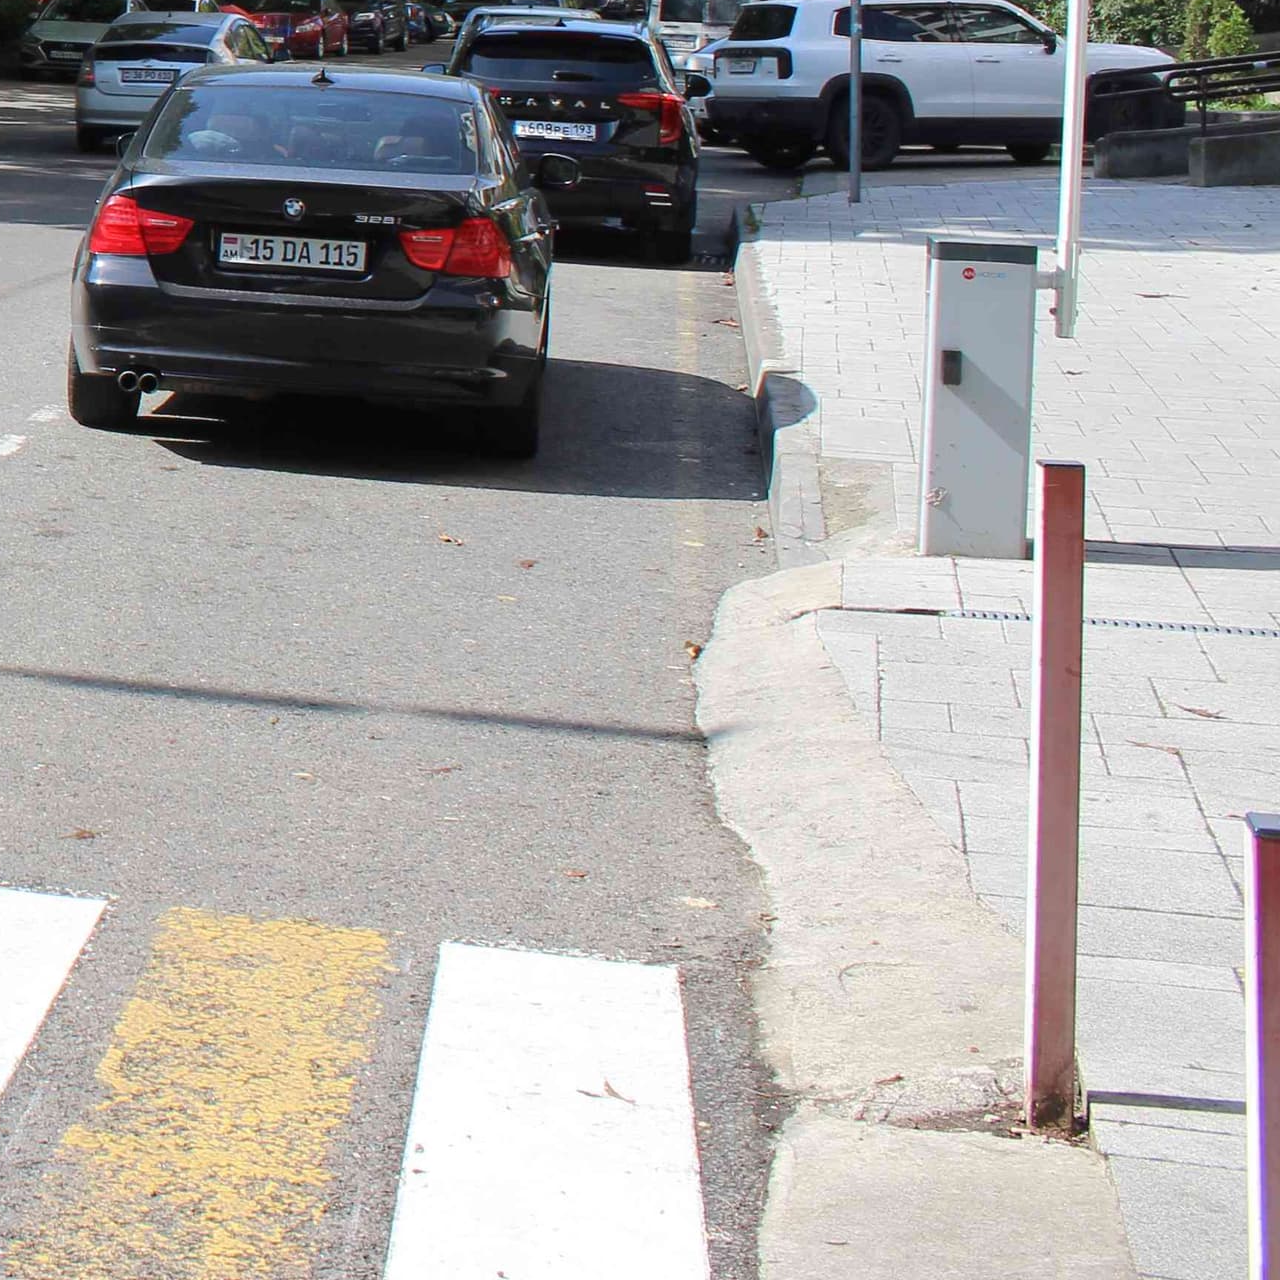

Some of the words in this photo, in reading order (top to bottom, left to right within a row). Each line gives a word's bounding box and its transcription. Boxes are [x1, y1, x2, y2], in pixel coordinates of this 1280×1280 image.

[573, 123, 593, 135] 193
[354, 215, 402, 225] 328i
[222, 249, 238, 260] AM
[249, 238, 275, 261] 15
[282, 240, 312, 265] DA
[319, 244, 359, 268] 115
